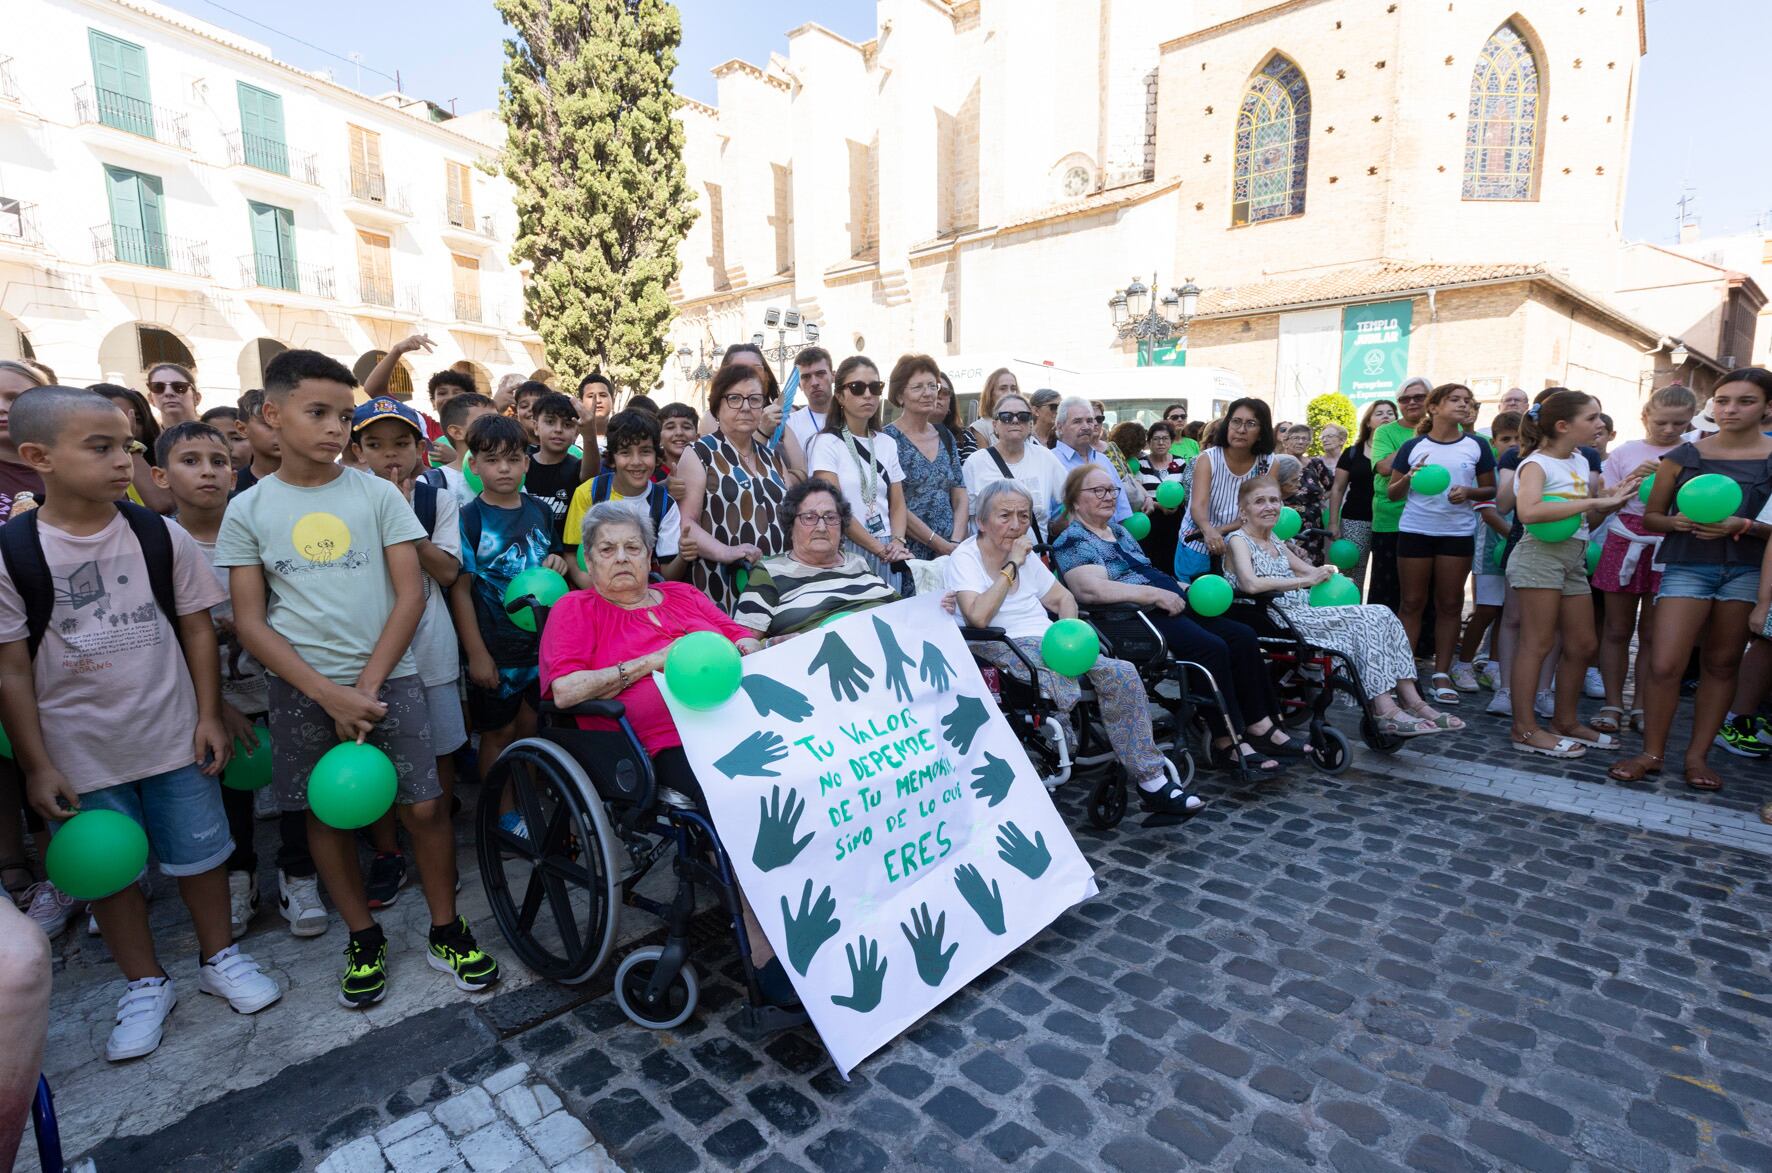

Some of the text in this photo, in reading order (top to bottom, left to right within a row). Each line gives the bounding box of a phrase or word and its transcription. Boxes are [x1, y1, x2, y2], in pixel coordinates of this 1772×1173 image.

[1357, 319, 1398, 333] TEMPLO
[948, 368, 983, 379] SAFOR
[793, 707, 918, 762] TU VALOR
[819, 728, 936, 797] NO DEPENDE
[828, 799, 853, 828] DE
[858, 787, 881, 813] TU
[886, 808, 907, 833] DE
[919, 799, 936, 818] LO
[883, 820, 952, 883] ERES
